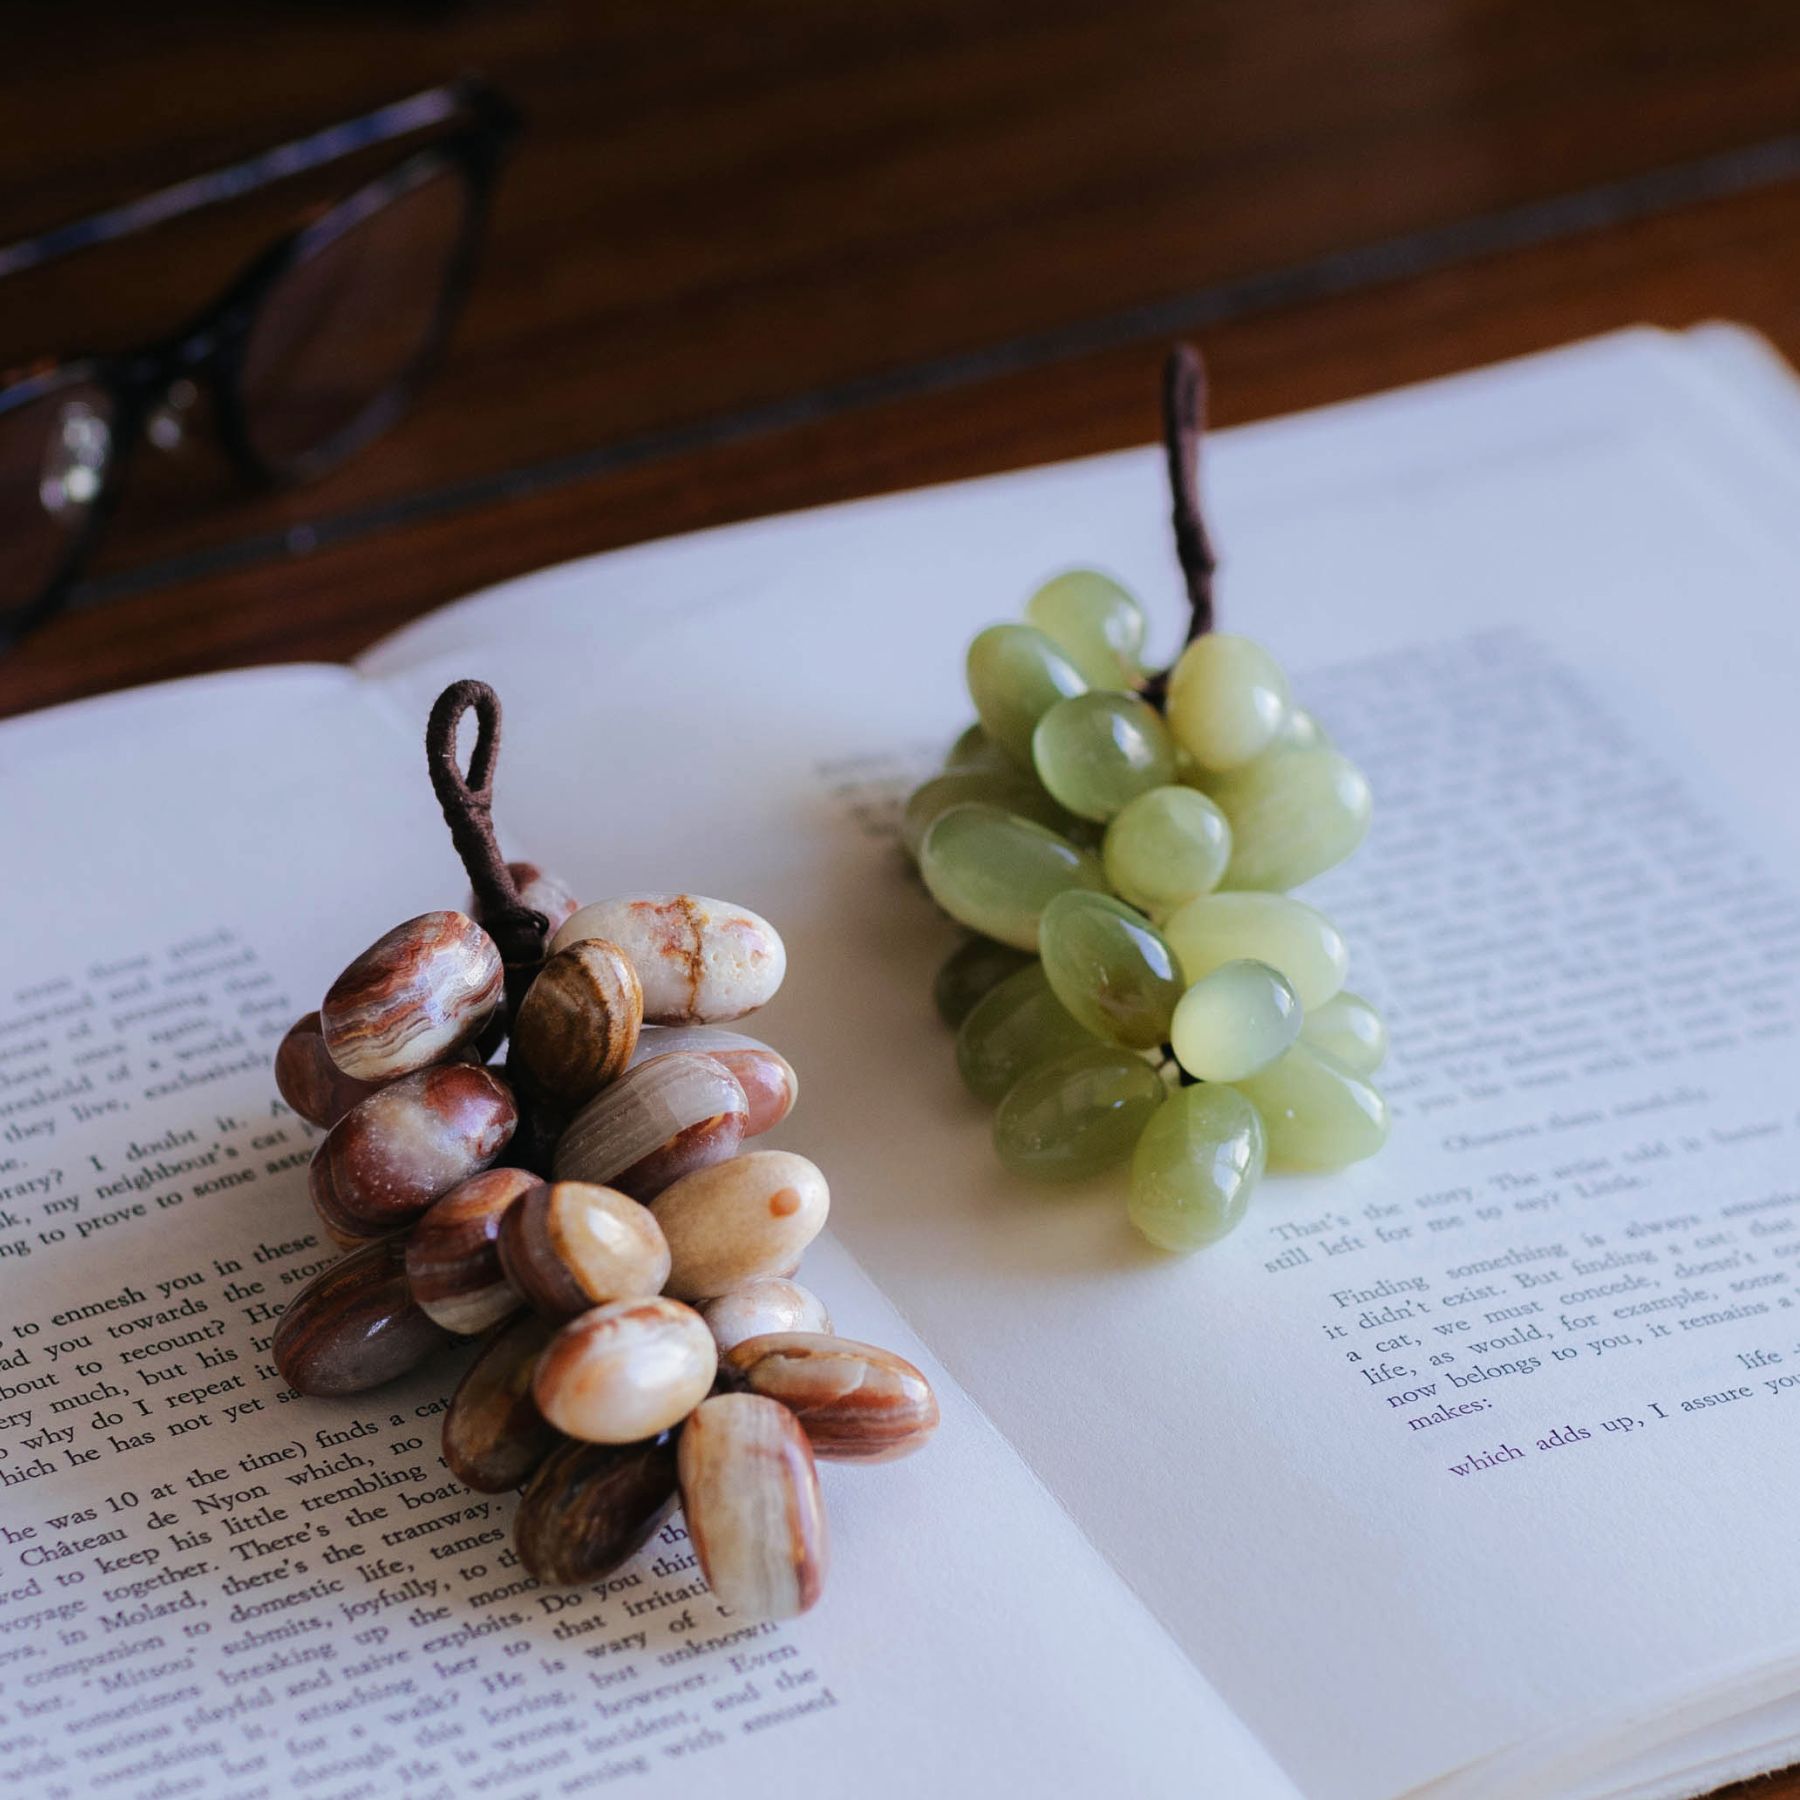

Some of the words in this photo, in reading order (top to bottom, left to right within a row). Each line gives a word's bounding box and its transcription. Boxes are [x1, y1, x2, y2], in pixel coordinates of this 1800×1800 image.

[0, 1169, 63, 1199] rary?
[89, 1154, 106, 1172] I
[126, 1128, 198, 1163] doubt
[0, 1239, 31, 1258] ng
[38, 1228, 65, 1246] to
[75, 1202, 147, 1238] prove
[156, 1189, 184, 1209] to
[192, 1167, 257, 1197] some
[265, 1148, 315, 1175] asto
[43, 1194, 80, 1216] my
[95, 1142, 238, 1200] neighbour's
[251, 1129, 289, 1150] cat
[1264, 1247, 1312, 1274] still
[1318, 1234, 1367, 1257] left
[1375, 1226, 1414, 1244] for
[1270, 1212, 1351, 1242] That's
[0, 1347, 31, 1371] ad
[43, 1334, 93, 1361] you
[107, 1300, 209, 1340] towards
[222, 1280, 266, 1304] the
[280, 1254, 339, 1285] stor
[12, 1321, 40, 1339] to
[50, 1286, 147, 1327] enmesh
[156, 1272, 206, 1299] you
[212, 1257, 243, 1277] in
[253, 1233, 319, 1264] these
[1322, 1325, 1348, 1341] it
[1358, 1299, 1431, 1330] didn't
[1442, 1284, 1507, 1307] exist.
[1514, 1268, 1563, 1289] But
[1571, 1250, 1658, 1276] finding
[1329, 1275, 1430, 1309] Finding
[1446, 1244, 1568, 1279] something
[1346, 1350, 1362, 1363] a
[1375, 1333, 1422, 1354] cat,
[1433, 1319, 1471, 1336] we
[1483, 1300, 1544, 1325] must
[1560, 1273, 1661, 1306] concede,
[1674, 1250, 1758, 1280] doesn't
[0, 1372, 60, 1400] bout
[75, 1360, 102, 1378] to
[118, 1319, 227, 1364] recount?
[242, 1302, 285, 1325] He
[1360, 1363, 1417, 1386] life,
[1429, 1351, 1455, 1368] as
[1467, 1324, 1554, 1355] would,
[1560, 1314, 1600, 1332] for
[1612, 1287, 1719, 1320] example,
[1729, 1272, 1791, 1293] some
[1387, 1382, 1438, 1409] now
[1444, 1356, 1542, 1389] belongs
[1552, 1346, 1577, 1361] to
[1587, 1334, 1643, 1355] you,
[1646, 1323, 1672, 1338] it
[1678, 1301, 1770, 1331] remains
[1777, 1297, 1794, 1308] a
[1737, 1350, 1783, 1370] life
[0, 1410, 32, 1430] ery
[49, 1381, 130, 1414] much,
[136, 1362, 188, 1387] but
[196, 1347, 239, 1371] his
[0, 1459, 58, 1487] hich
[63, 1447, 102, 1468] he
[107, 1429, 156, 1454] has
[167, 1414, 213, 1438] not
[222, 1397, 265, 1423] yet
[276, 1387, 303, 1404] sa
[20, 1425, 75, 1451] why
[91, 1411, 124, 1432] do
[132, 1399, 153, 1417] I
[165, 1375, 246, 1409] repeat
[1407, 1395, 1494, 1432] makes:
[1448, 1443, 1525, 1480] which
[1535, 1425, 1592, 1452] adds
[1600, 1414, 1644, 1432] up,
[1647, 1403, 1669, 1420] I
[1680, 1383, 1755, 1413] assure
[1, 1525, 38, 1544] he
[45, 1508, 98, 1531] was
[105, 1491, 140, 1514] 10
[150, 1483, 178, 1501] at
[186, 1466, 231, 1489] the
[238, 1441, 307, 1473] time)
[315, 1420, 380, 1449] finds
[389, 1414, 405, 1427] a
[415, 1398, 449, 1417] cat
[19, 1527, 129, 1567] Château
[146, 1511, 180, 1530] de
[192, 1484, 270, 1515] Nyon
[285, 1451, 375, 1487] which,
[389, 1437, 423, 1456] no
[56, 1571, 85, 1587] to
[94, 1548, 160, 1574] keep
[168, 1531, 213, 1552] his
[221, 1506, 289, 1537] little
[301, 1464, 428, 1513] trembling
[102, 1561, 220, 1602] together.
[230, 1522, 331, 1563] There's
[345, 1507, 390, 1528] the
[397, 1482, 472, 1510] boat,
[23, 1635, 165, 1687] companion
[182, 1621, 212, 1638] to
[230, 1578, 344, 1624] domestic
[356, 1559, 415, 1584] life,
[430, 1526, 505, 1561] tames
[58, 1628, 89, 1647] in
[98, 1590, 208, 1634] Molard,
[221, 1558, 309, 1597] there's
[322, 1543, 366, 1566] the
[381, 1502, 503, 1547] tramway.
[221, 1616, 333, 1656] submits,
[339, 1579, 451, 1624] joyfully,
[459, 1563, 487, 1582] to
[422, 1610, 533, 1653] exploits.
[537, 1592, 582, 1615] Do
[592, 1572, 642, 1601] you
[217, 1643, 338, 1687] breaking
[353, 1625, 389, 1645] up
[408, 1605, 452, 1628] the
[468, 1576, 540, 1610] mono
[432, 1655, 479, 1680] her
[502, 1640, 532, 1657] to
[552, 1614, 607, 1641] that
[584, 1630, 648, 1658] wary
[668, 1610, 697, 1633] of
